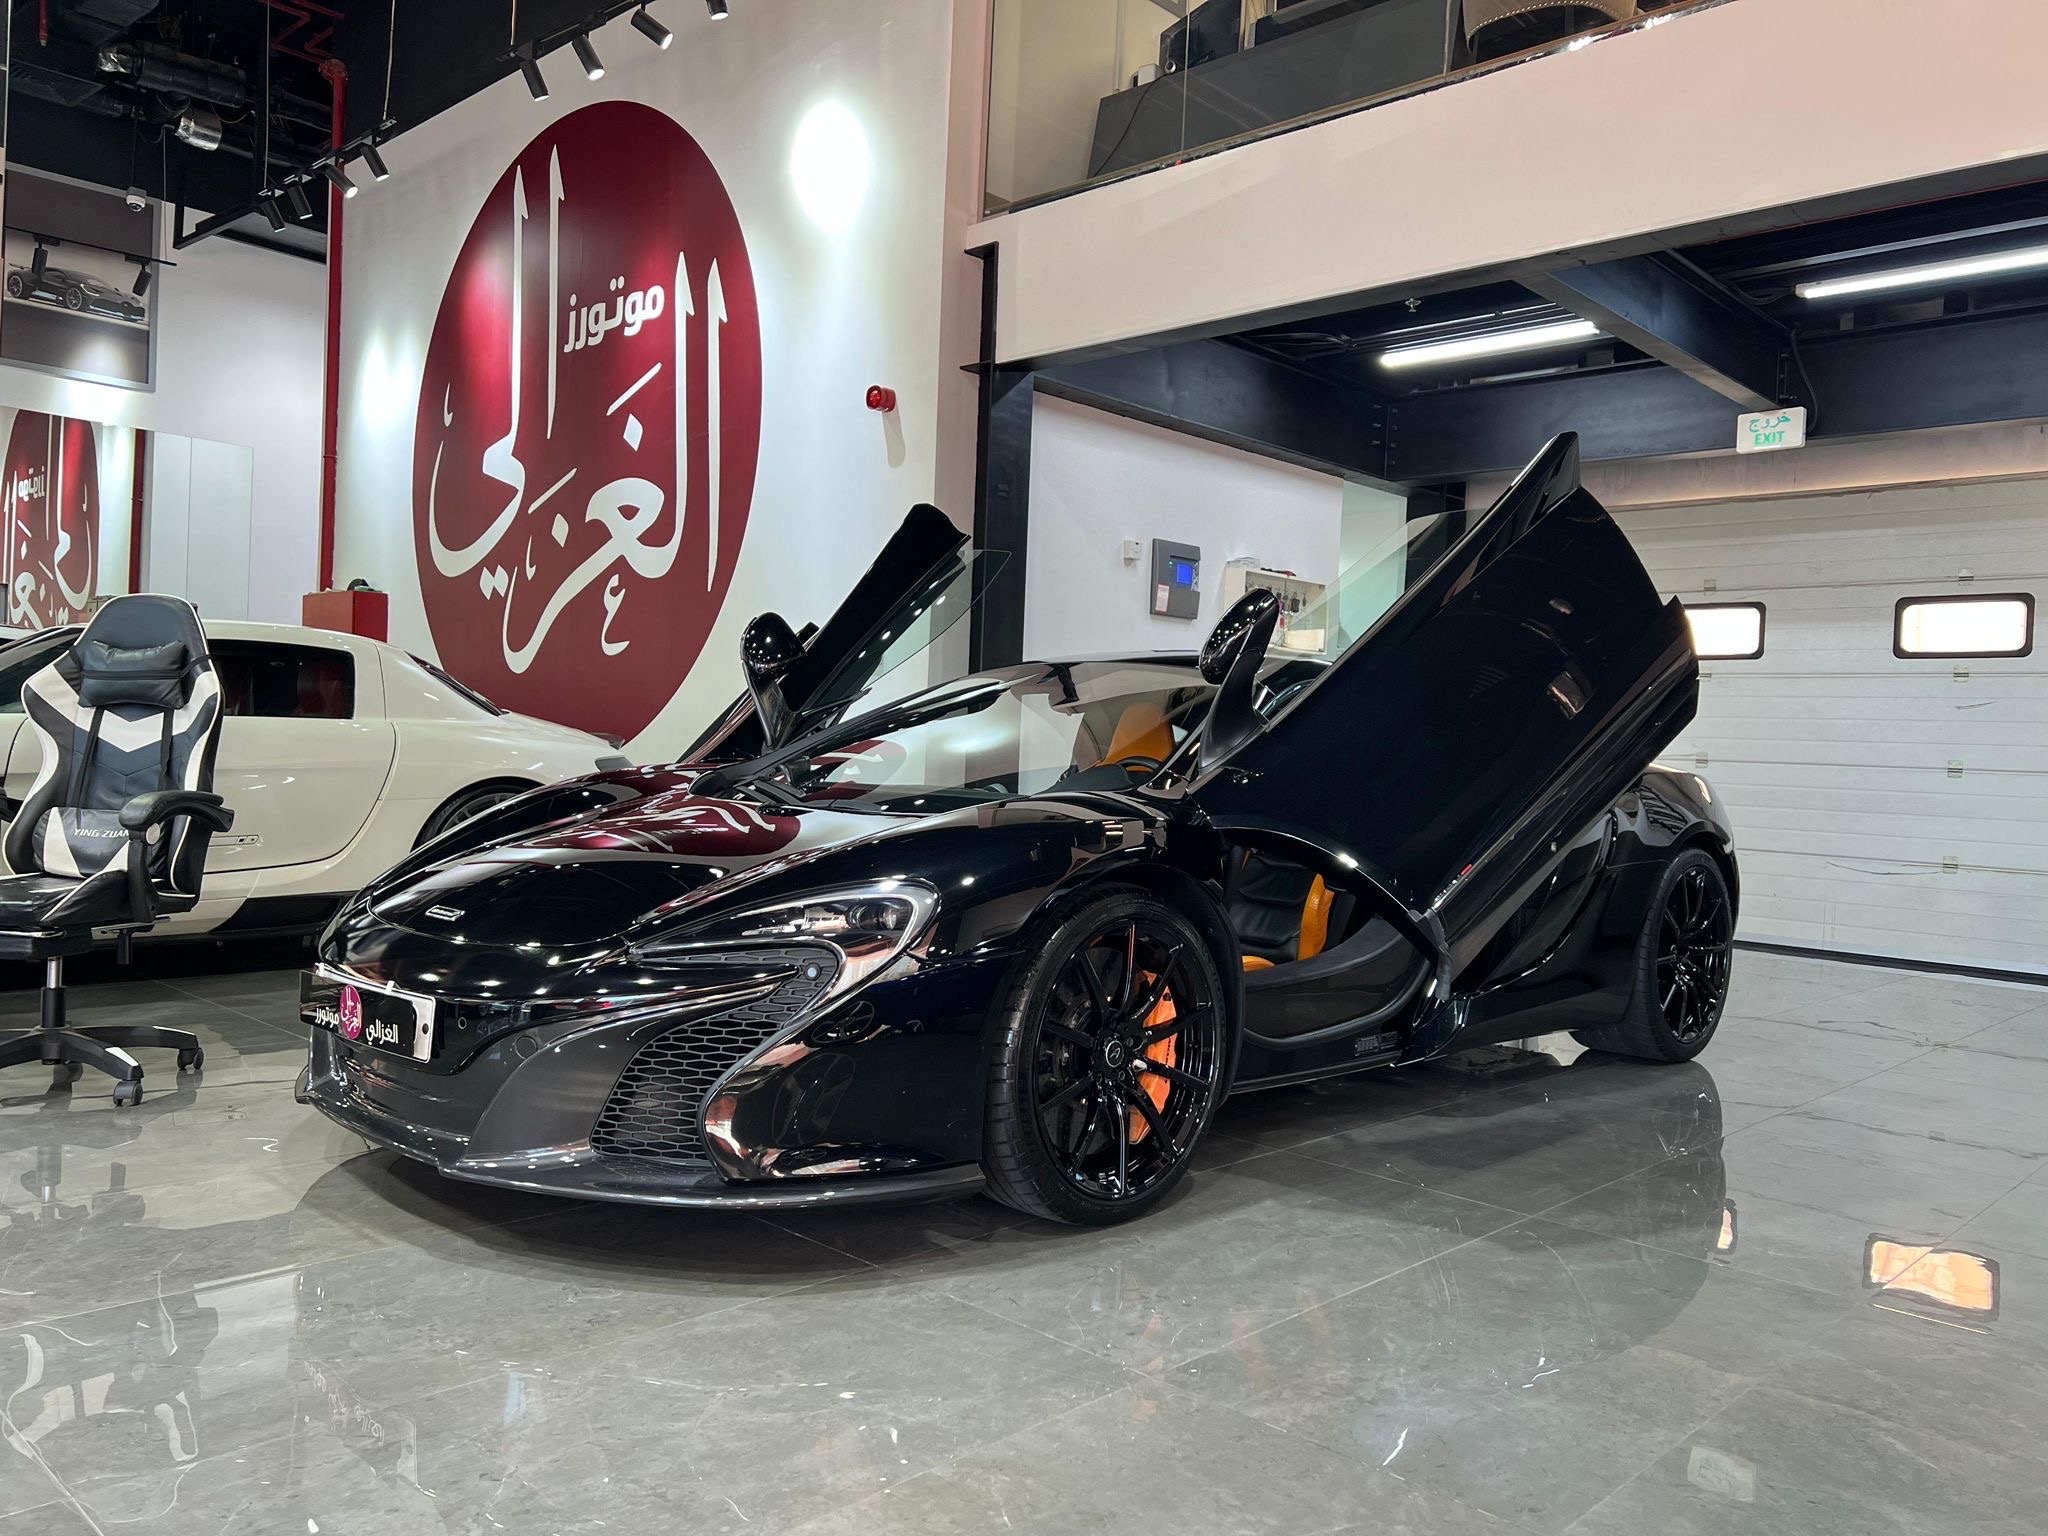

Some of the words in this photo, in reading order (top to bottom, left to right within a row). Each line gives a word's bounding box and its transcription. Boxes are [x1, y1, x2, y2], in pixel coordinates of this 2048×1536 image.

[563, 275, 665, 353] موتورز
[1748, 411, 1791, 433] خروج
[1754, 430, 1785, 446] EXIT
[74, 828, 100, 838] YING
[366, 1018, 399, 1046] الغزالي
